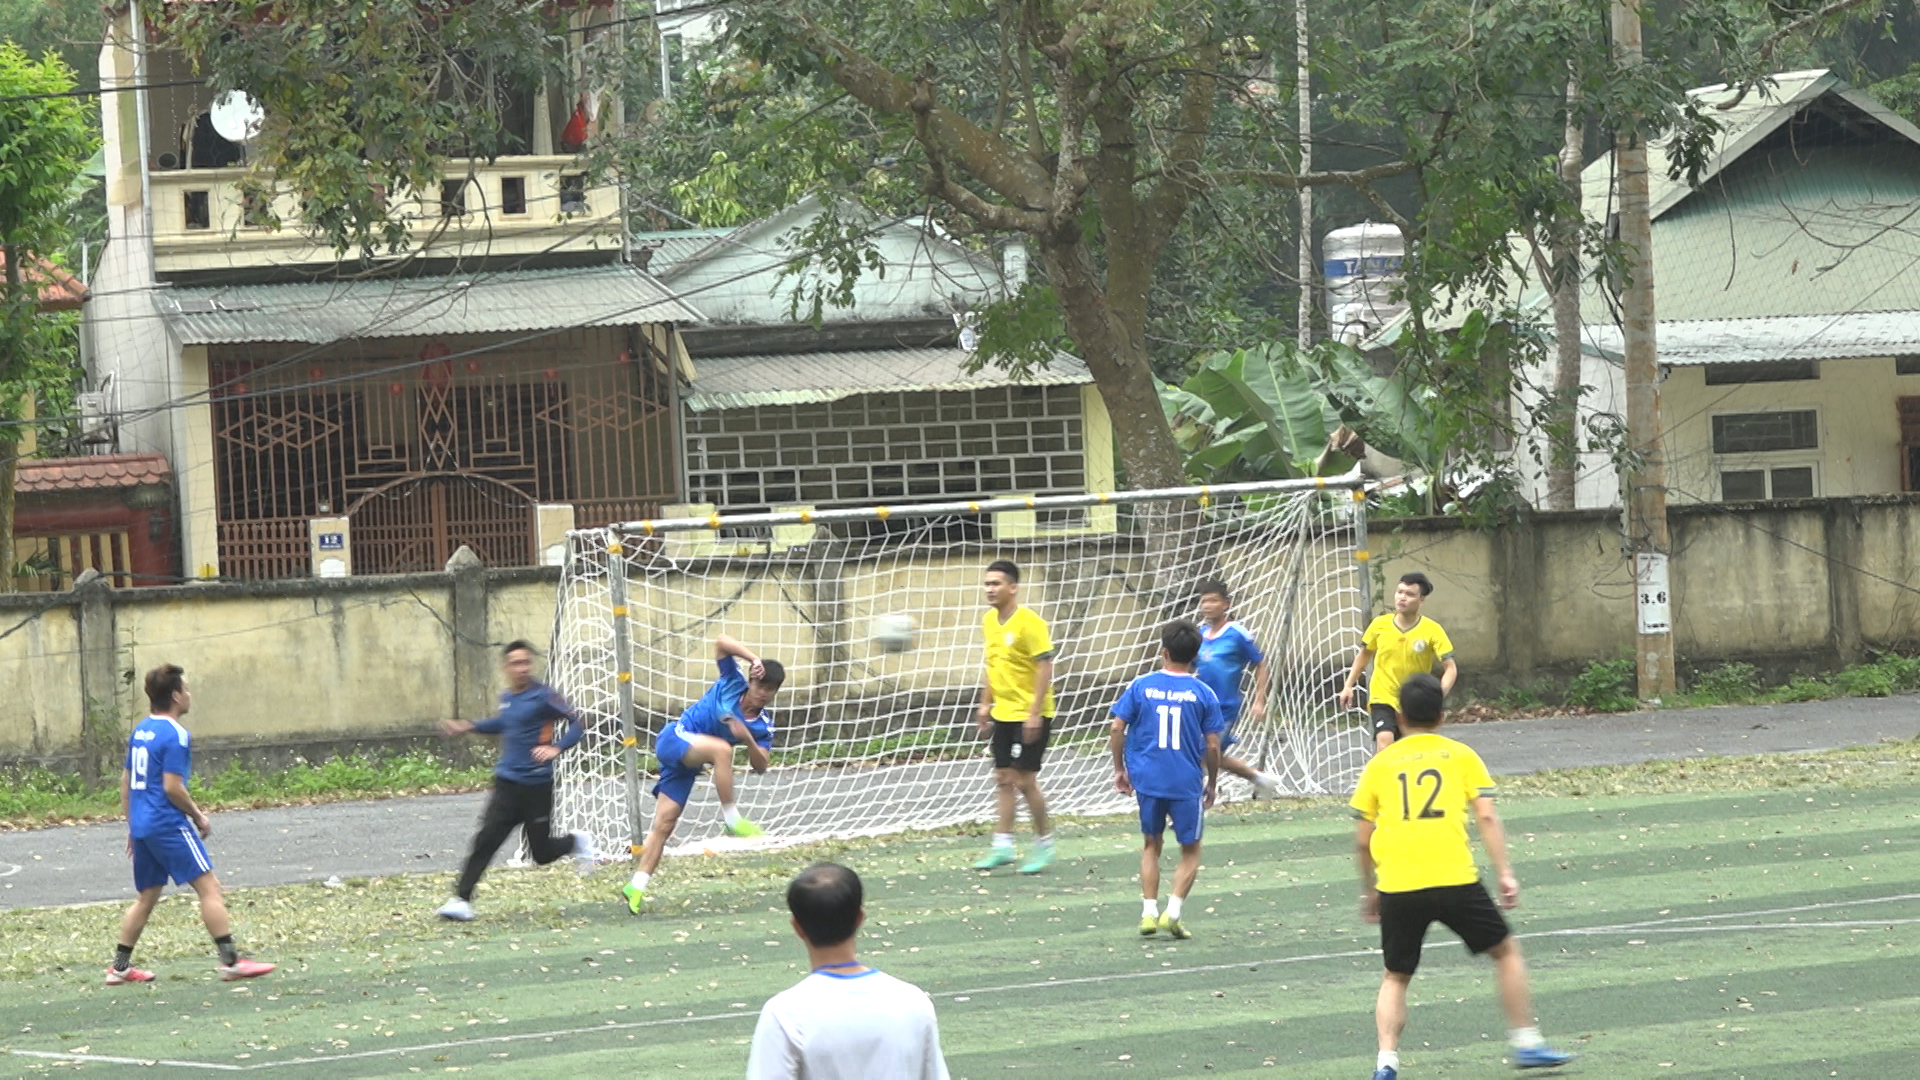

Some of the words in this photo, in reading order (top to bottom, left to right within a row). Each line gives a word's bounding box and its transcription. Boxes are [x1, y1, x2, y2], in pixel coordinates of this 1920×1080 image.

[1640, 591, 1666, 605] 3.6
[1156, 705, 1182, 751] 11
[131, 746, 149, 790] 19
[1397, 768, 1446, 821] 12
